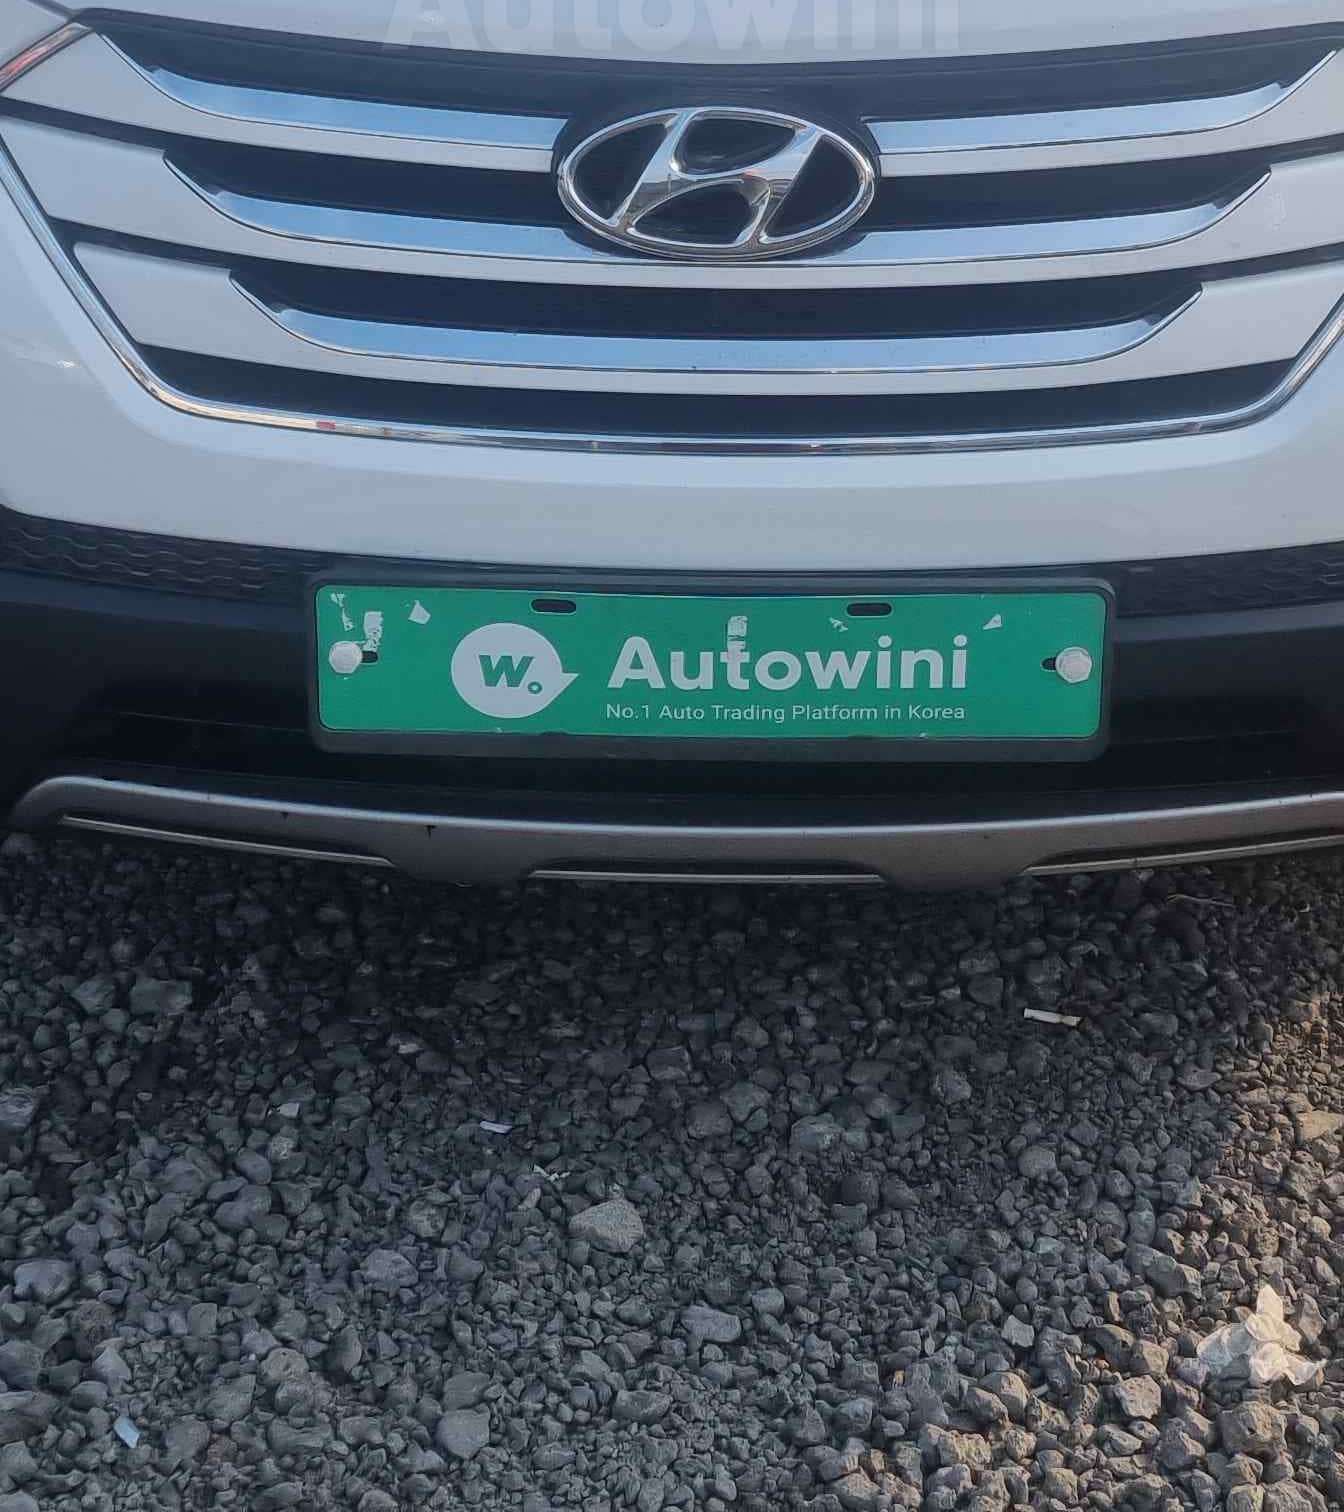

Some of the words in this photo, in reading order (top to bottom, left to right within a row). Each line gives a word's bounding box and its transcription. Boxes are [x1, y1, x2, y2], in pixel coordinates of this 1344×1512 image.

[607, 634, 968, 691] Autowini
[606, 703, 650, 720] No.1
[659, 704, 705, 720] Auto
[711, 704, 785, 724] Trading
[792, 704, 878, 720] Platform
[885, 704, 902, 720] in
[908, 704, 965, 720] Korea
